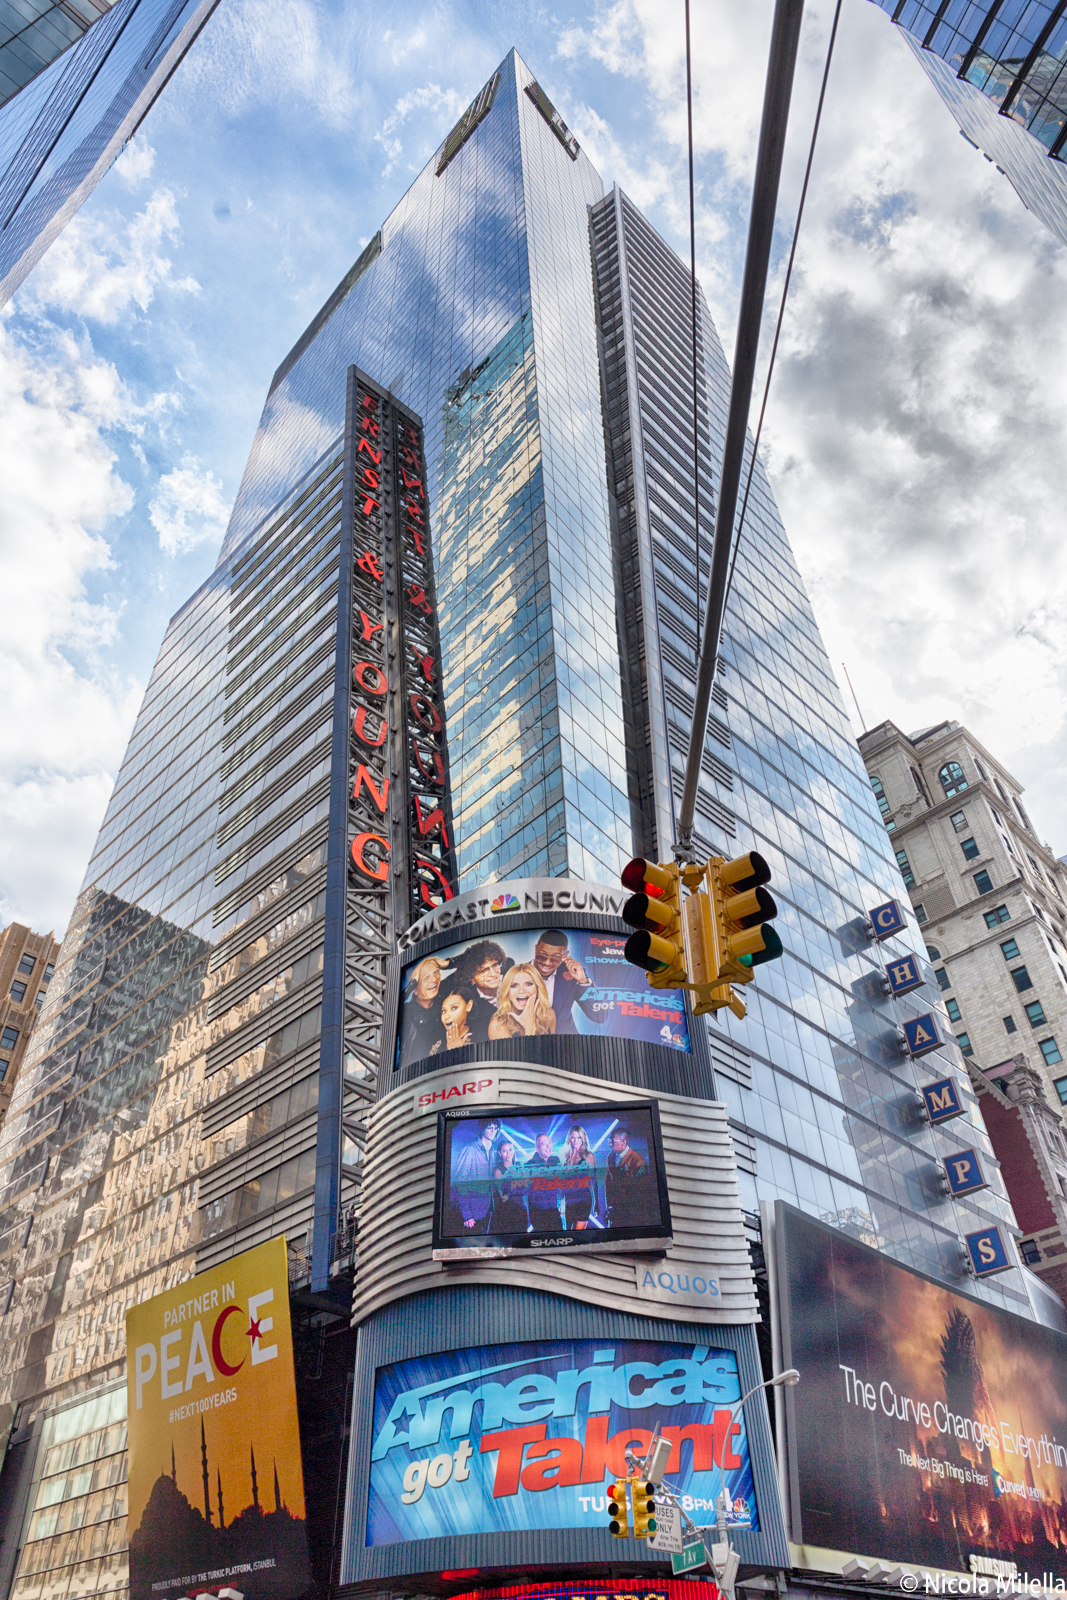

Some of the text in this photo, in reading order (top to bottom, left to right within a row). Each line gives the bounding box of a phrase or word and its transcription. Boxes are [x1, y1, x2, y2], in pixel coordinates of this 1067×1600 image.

[351, 394, 391, 883] ERNST & YOUNG
[399, 890, 628, 950] COMCAST NBCUNIV
[579, 986, 684, 1011] America's
[592, 1001, 683, 1025] got Talent
[660, 1024, 672, 1040] 4
[417, 1078, 494, 1108] SHARP
[445, 1110, 471, 1118] AQUOS
[530, 1175, 592, 1191] Talent
[530, 1236, 574, 1248] SHARP
[641, 1270, 720, 1297] AQUOS
[163, 1280, 236, 1330] PARTNER IN
[134, 1287, 279, 1411] PEACE
[168, 1386, 238, 1424] #NEXT100YEARS
[371, 1344, 742, 1462] America's
[839, 1364, 1067, 1468] The Curve Changes Everythin
[401, 1409, 741, 1505] got Talent
[897, 1448, 912, 1467] The
[912, 1453, 931, 1472] Next
[931, 1457, 944, 1479] Big
[944, 1461, 965, 1484] Thing
[965, 1470, 972, 1482] is
[997, 1474, 1027, 1500] Curved
[655, 1506, 674, 1519] USES
[734, 1512, 751, 1520] YORK
[151, 1579, 171, 1592] PROUDLY
[197, 1572, 208, 1582] THE
[207, 1568, 225, 1580] TURKIC
[225, 1562, 253, 1577] PLATFORM,
[252, 1557, 276, 1570] ISTANBUL
[968, 1553, 1018, 1580] SAMSUNG
